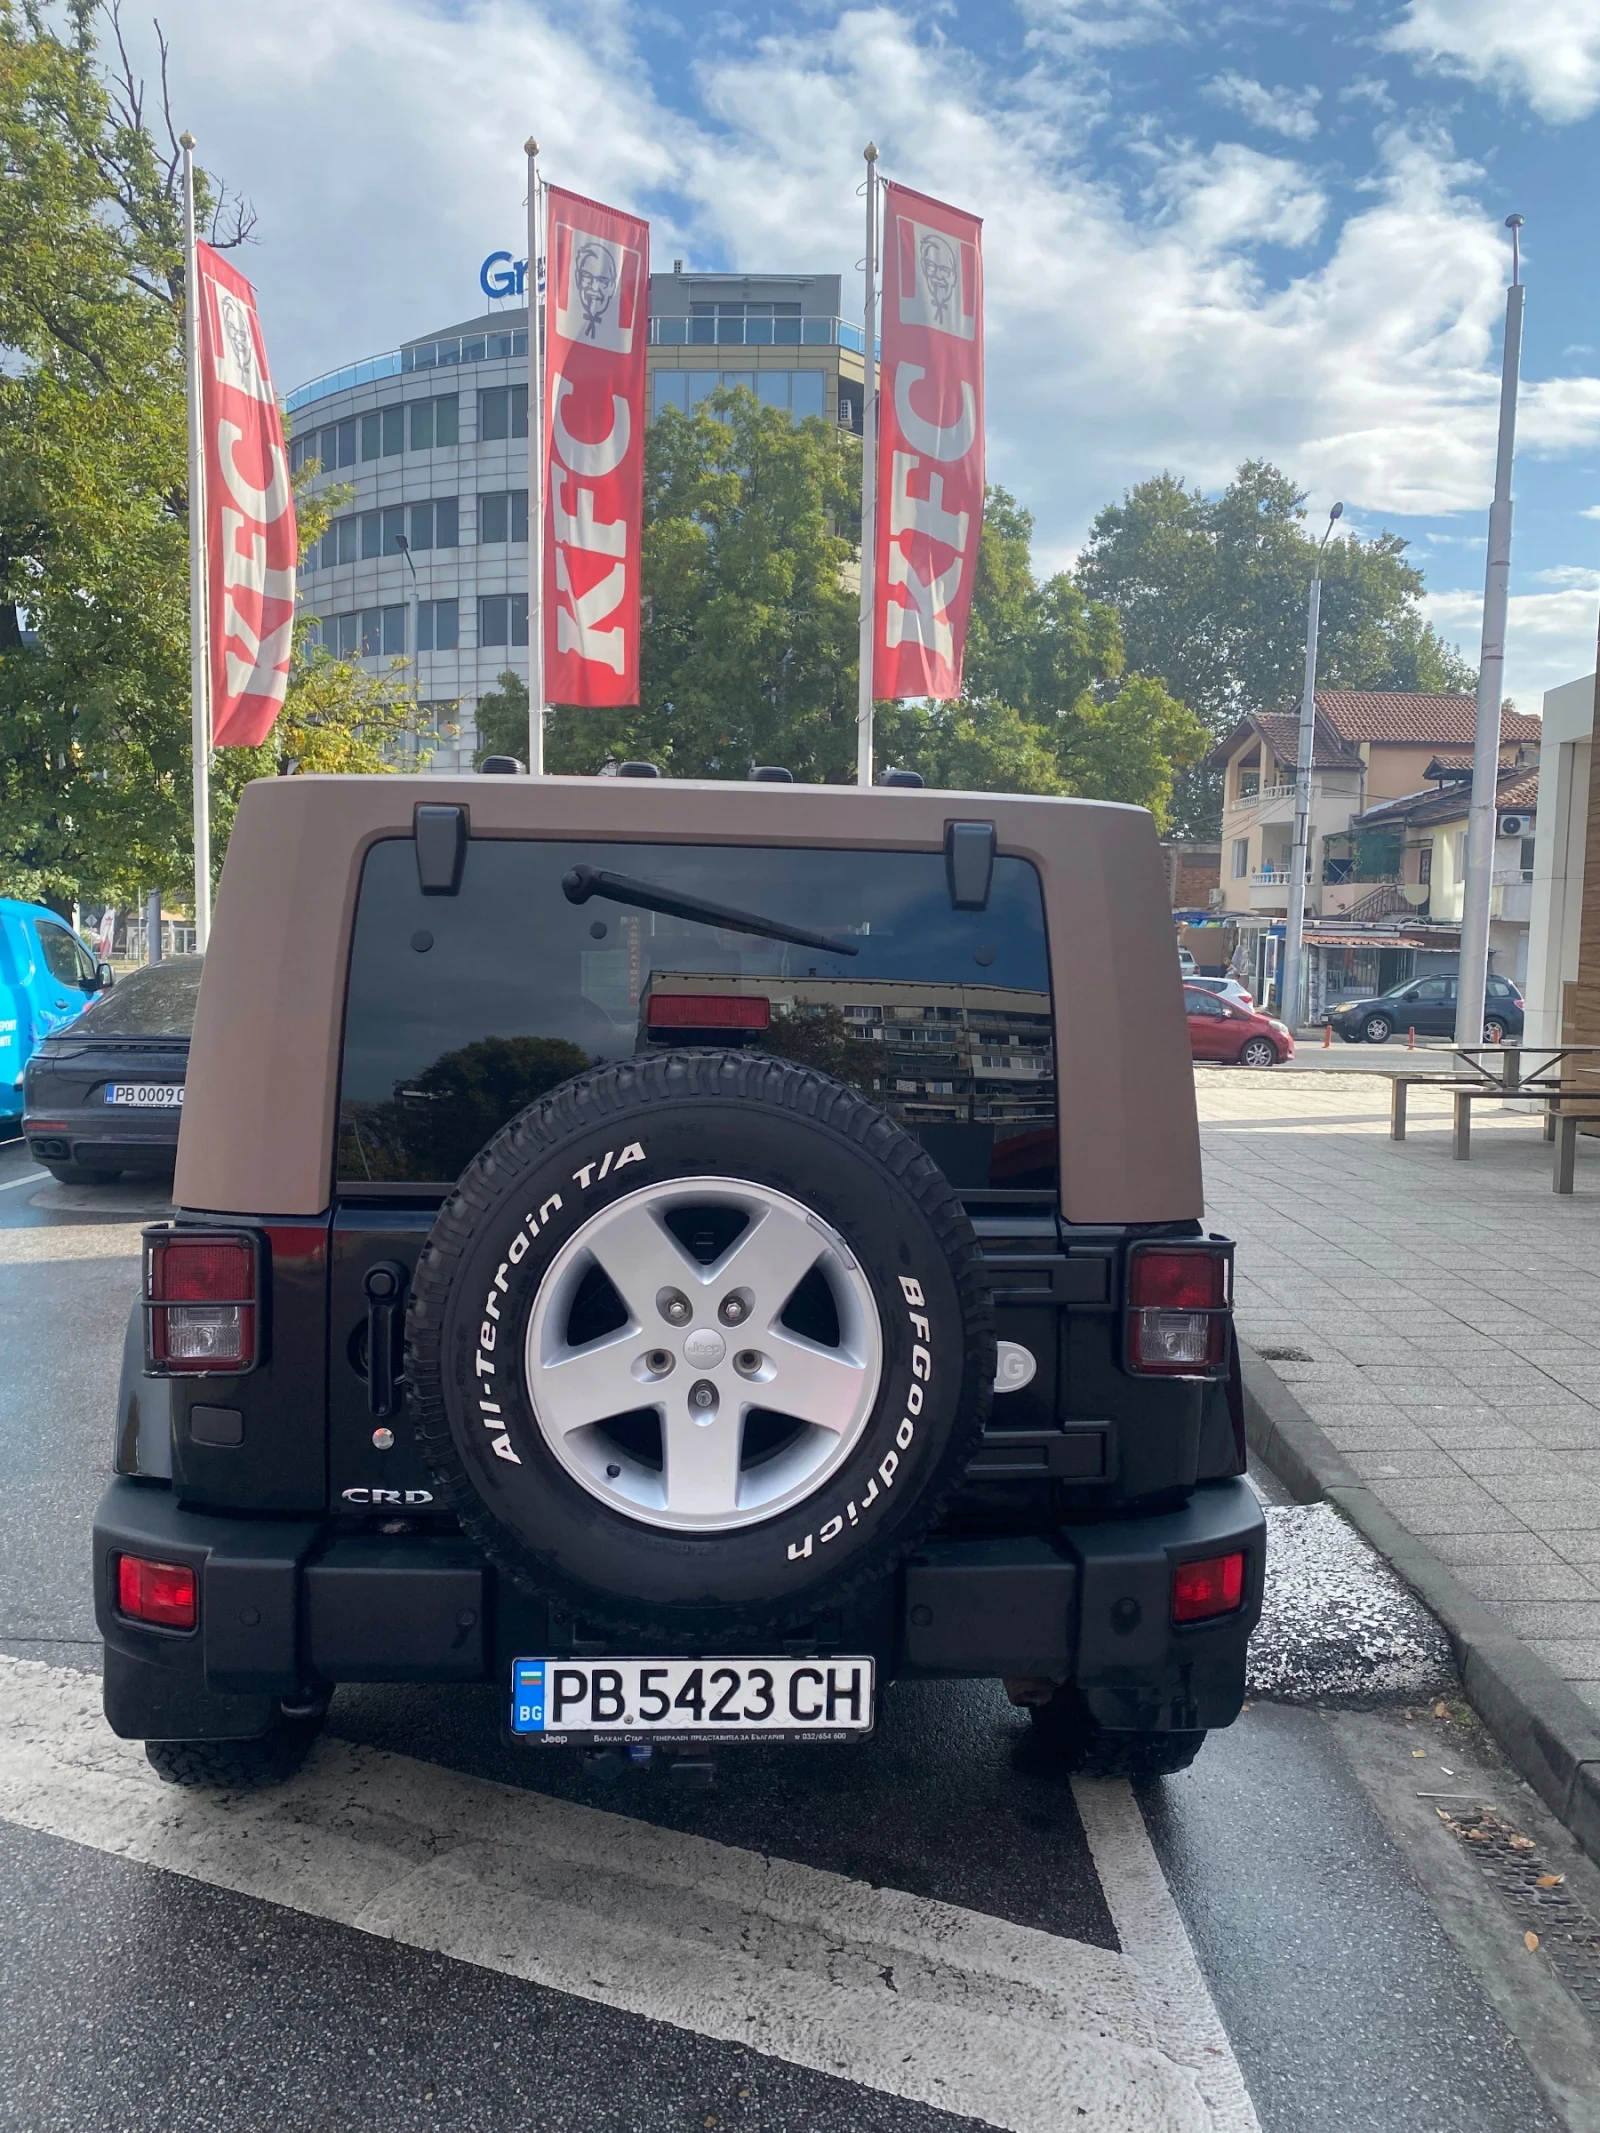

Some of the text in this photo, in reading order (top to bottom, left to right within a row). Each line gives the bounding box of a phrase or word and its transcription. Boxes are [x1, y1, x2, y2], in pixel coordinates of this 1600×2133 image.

[551, 371, 631, 676] KFC
[886, 361, 976, 670] KFC
[218, 417, 296, 703] KFC
[115, 1087, 135, 1102] PB
[138, 1087, 174, 1102] 0009
[476, 1142, 646, 1465] All-Terrain T/A
[688, 1341, 721, 1358] Jeep
[997, 1353, 1024, 1380] G
[787, 1275, 932, 1560] BFGoodrich
[341, 1488, 434, 1504] CRD
[552, 1667, 861, 1722] PB 5423 CH
[519, 1705, 542, 1721] BG
[541, 1733, 568, 1745] Jeep
[802, 1732, 847, 1741] 032/654 600
